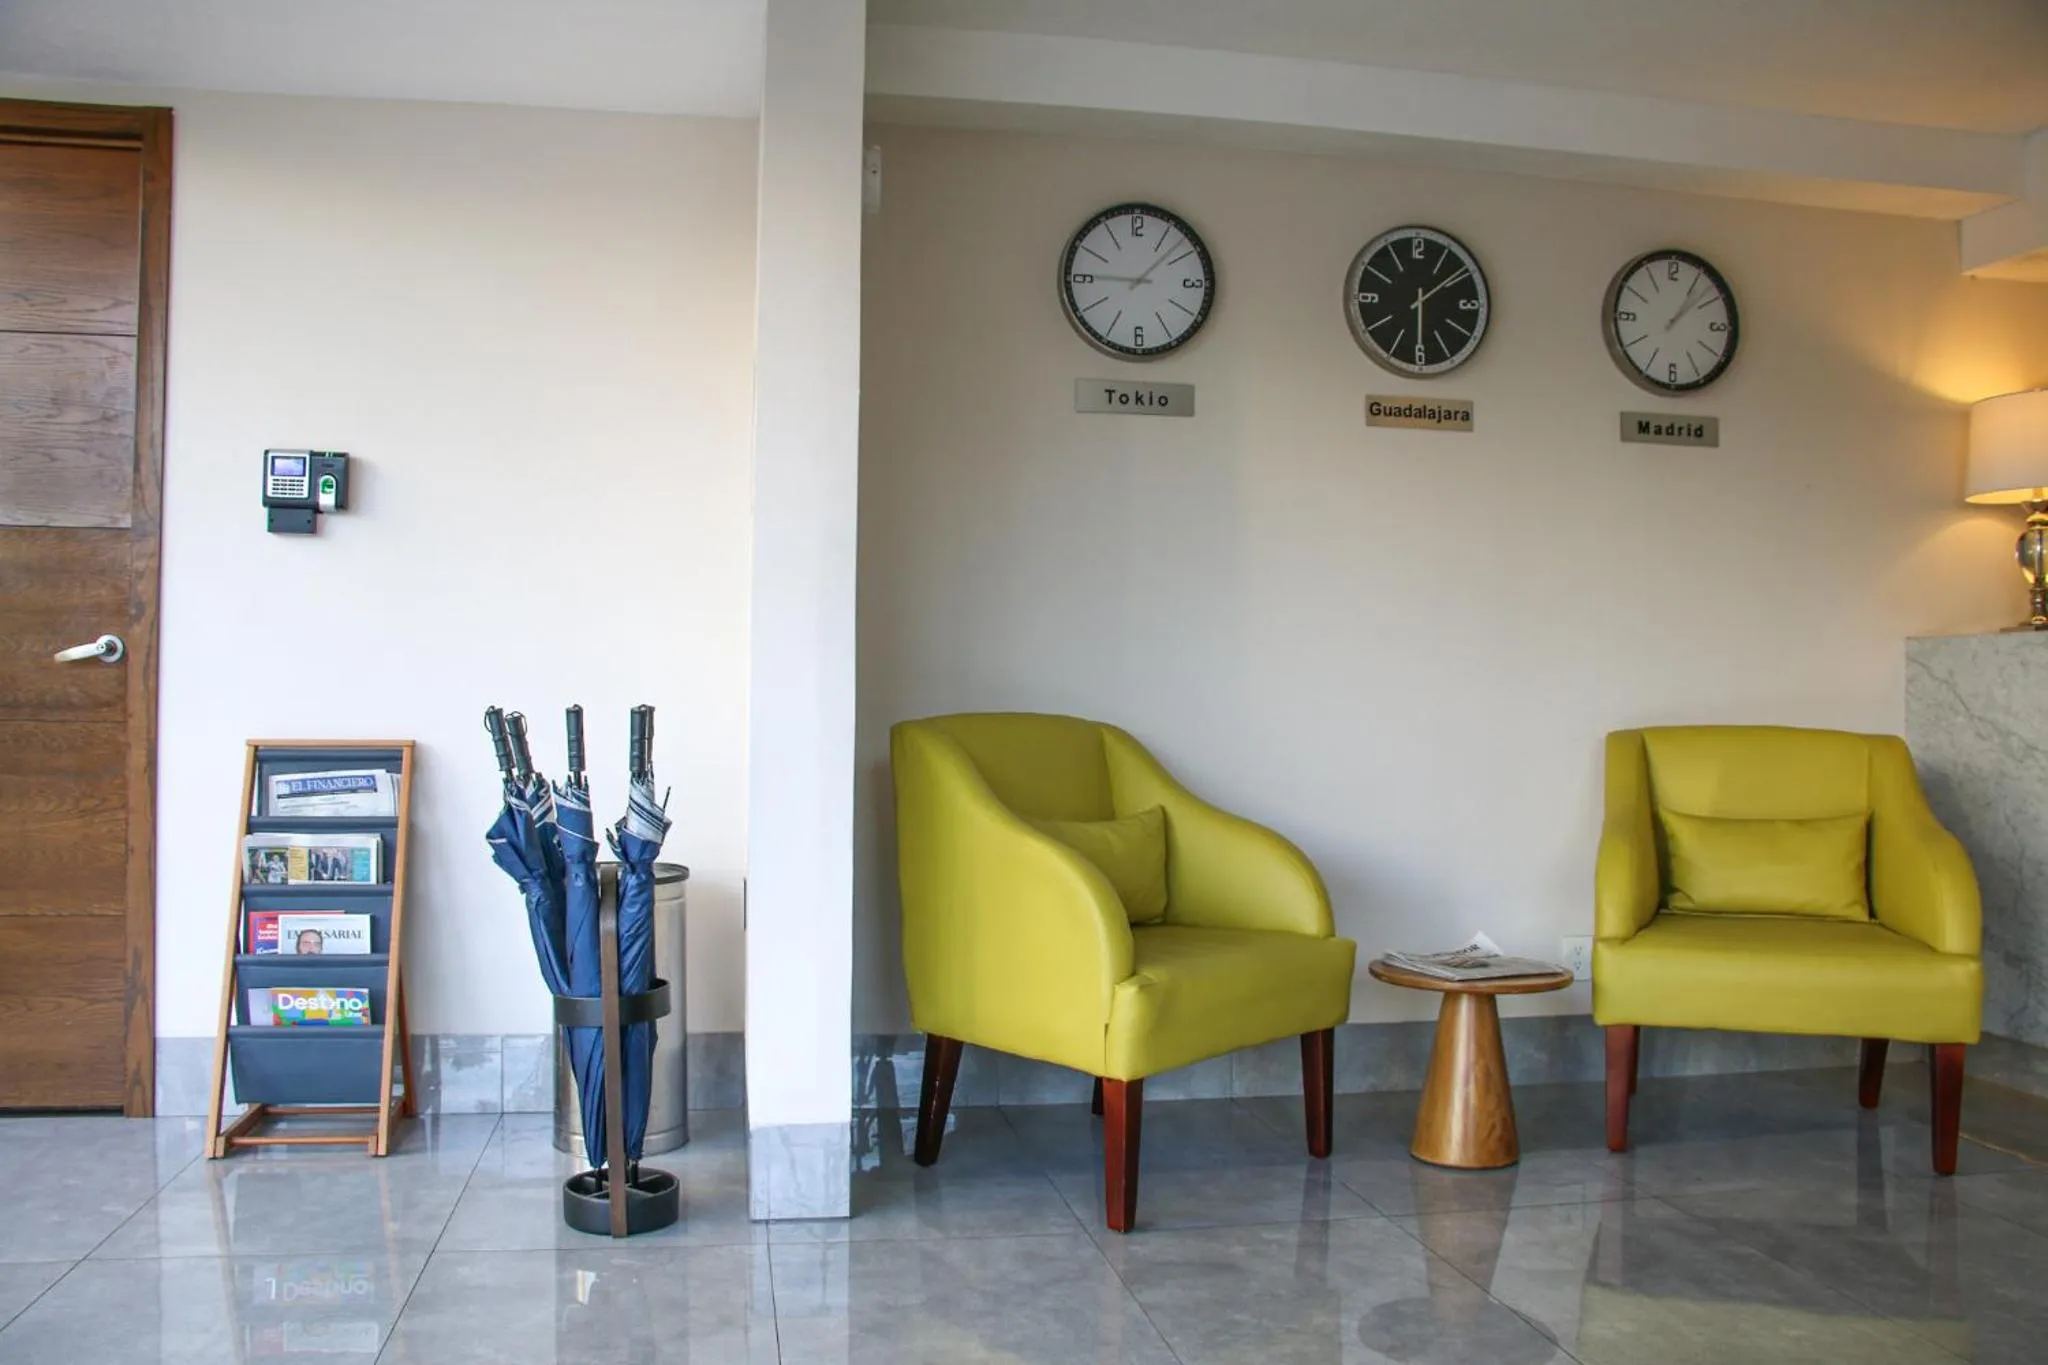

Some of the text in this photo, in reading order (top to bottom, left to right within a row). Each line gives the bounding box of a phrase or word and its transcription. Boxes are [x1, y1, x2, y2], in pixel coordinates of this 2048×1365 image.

[1131, 215, 1144, 237] 12
[1412, 238, 1425, 259] 12
[1072, 273, 1095, 284] 9
[1668, 261, 1679, 282] 12
[1182, 278, 1204, 289] 3
[1358, 292, 1380, 304] 9
[1458, 299, 1480, 310] 3
[1709, 321, 1727, 333] 3
[1134, 326, 1144, 347] 6
[1415, 344, 1425, 365] 6
[1668, 363, 1678, 383] 6
[1104, 389, 1169, 406] Tokio
[1369, 401, 1471, 424] Guadalajara
[1637, 420, 1704, 438] Madrid
[291, 781, 303, 792] EL
